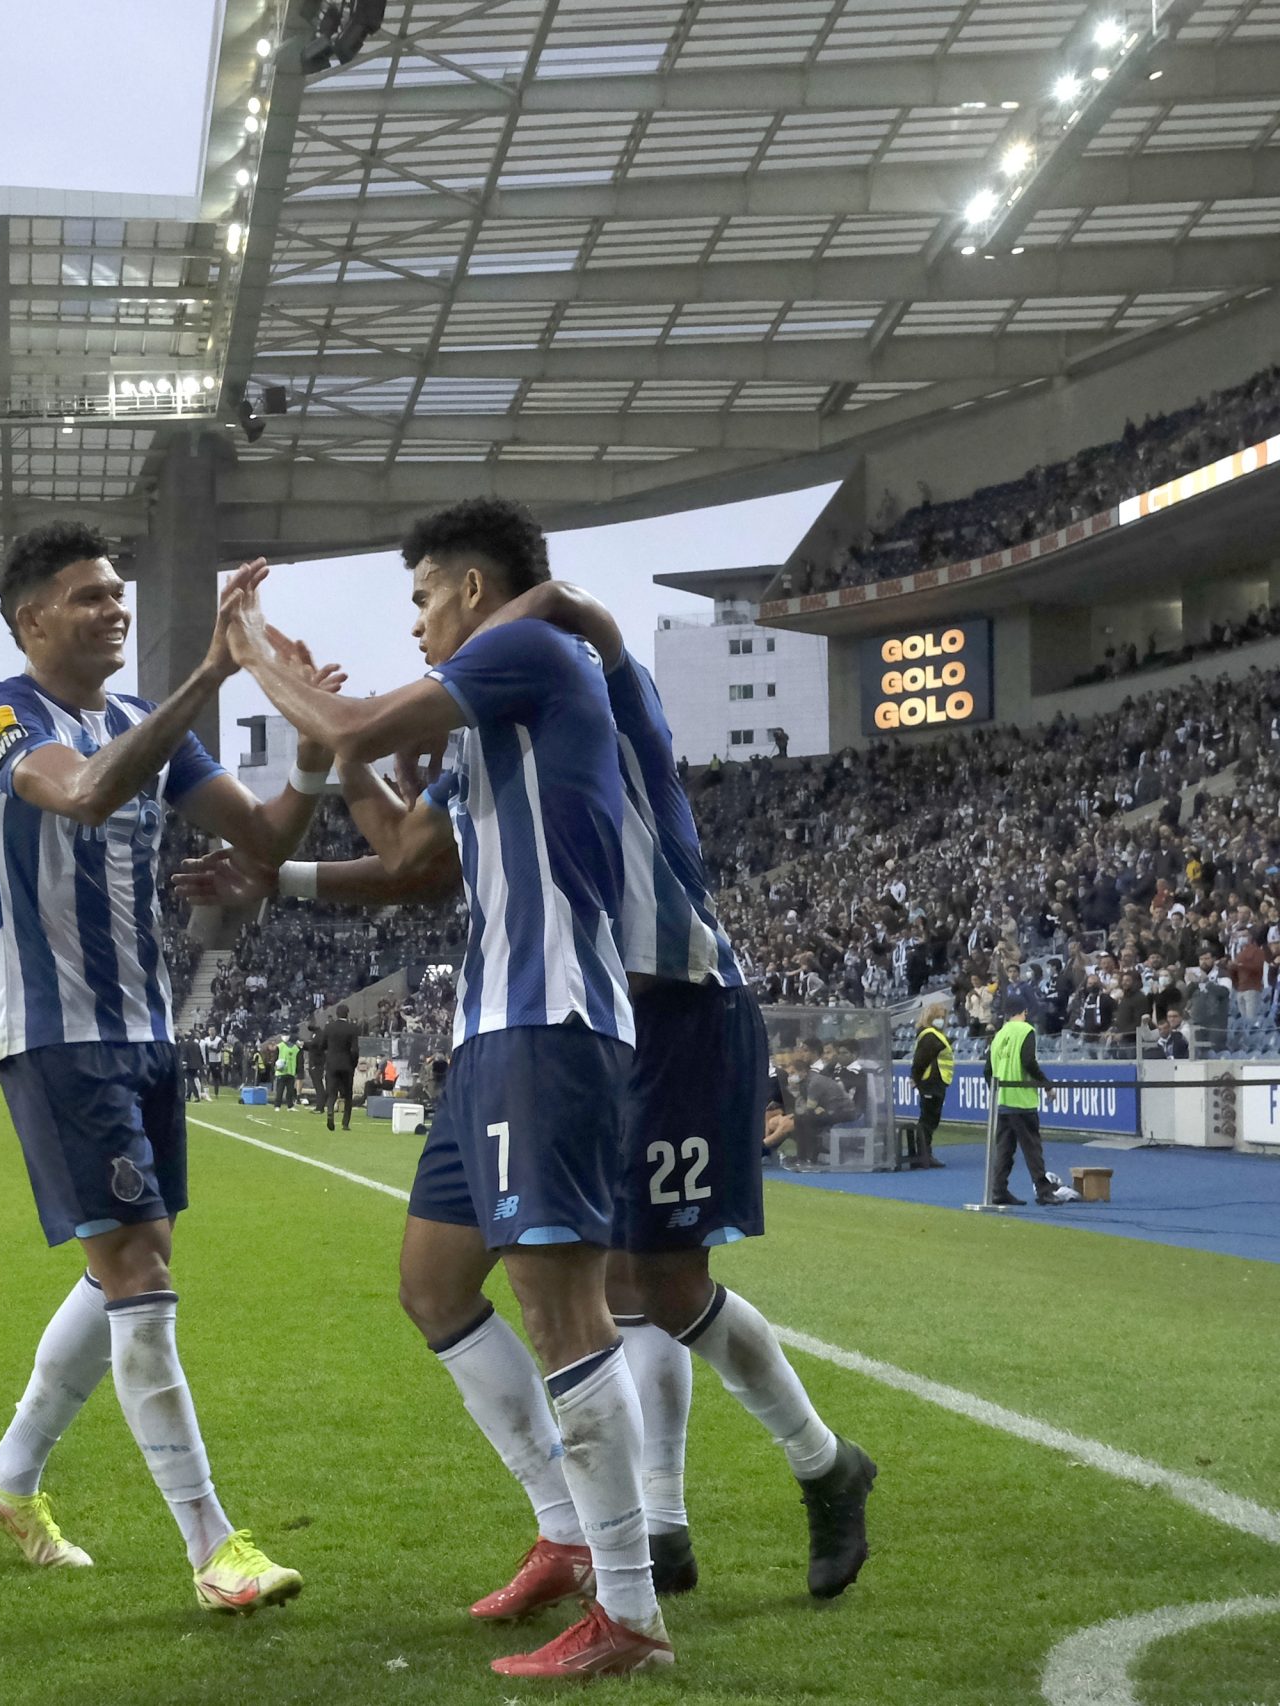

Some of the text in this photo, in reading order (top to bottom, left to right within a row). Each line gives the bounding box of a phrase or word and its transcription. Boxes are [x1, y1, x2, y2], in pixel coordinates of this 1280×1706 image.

[881, 628, 965, 663] GOLO
[881, 661, 966, 695] GOLO
[874, 690, 974, 729] GOLO
[1072, 1079, 1116, 1117] PORTO
[486, 1121, 511, 1192] 7
[646, 1136, 712, 1205] 22
